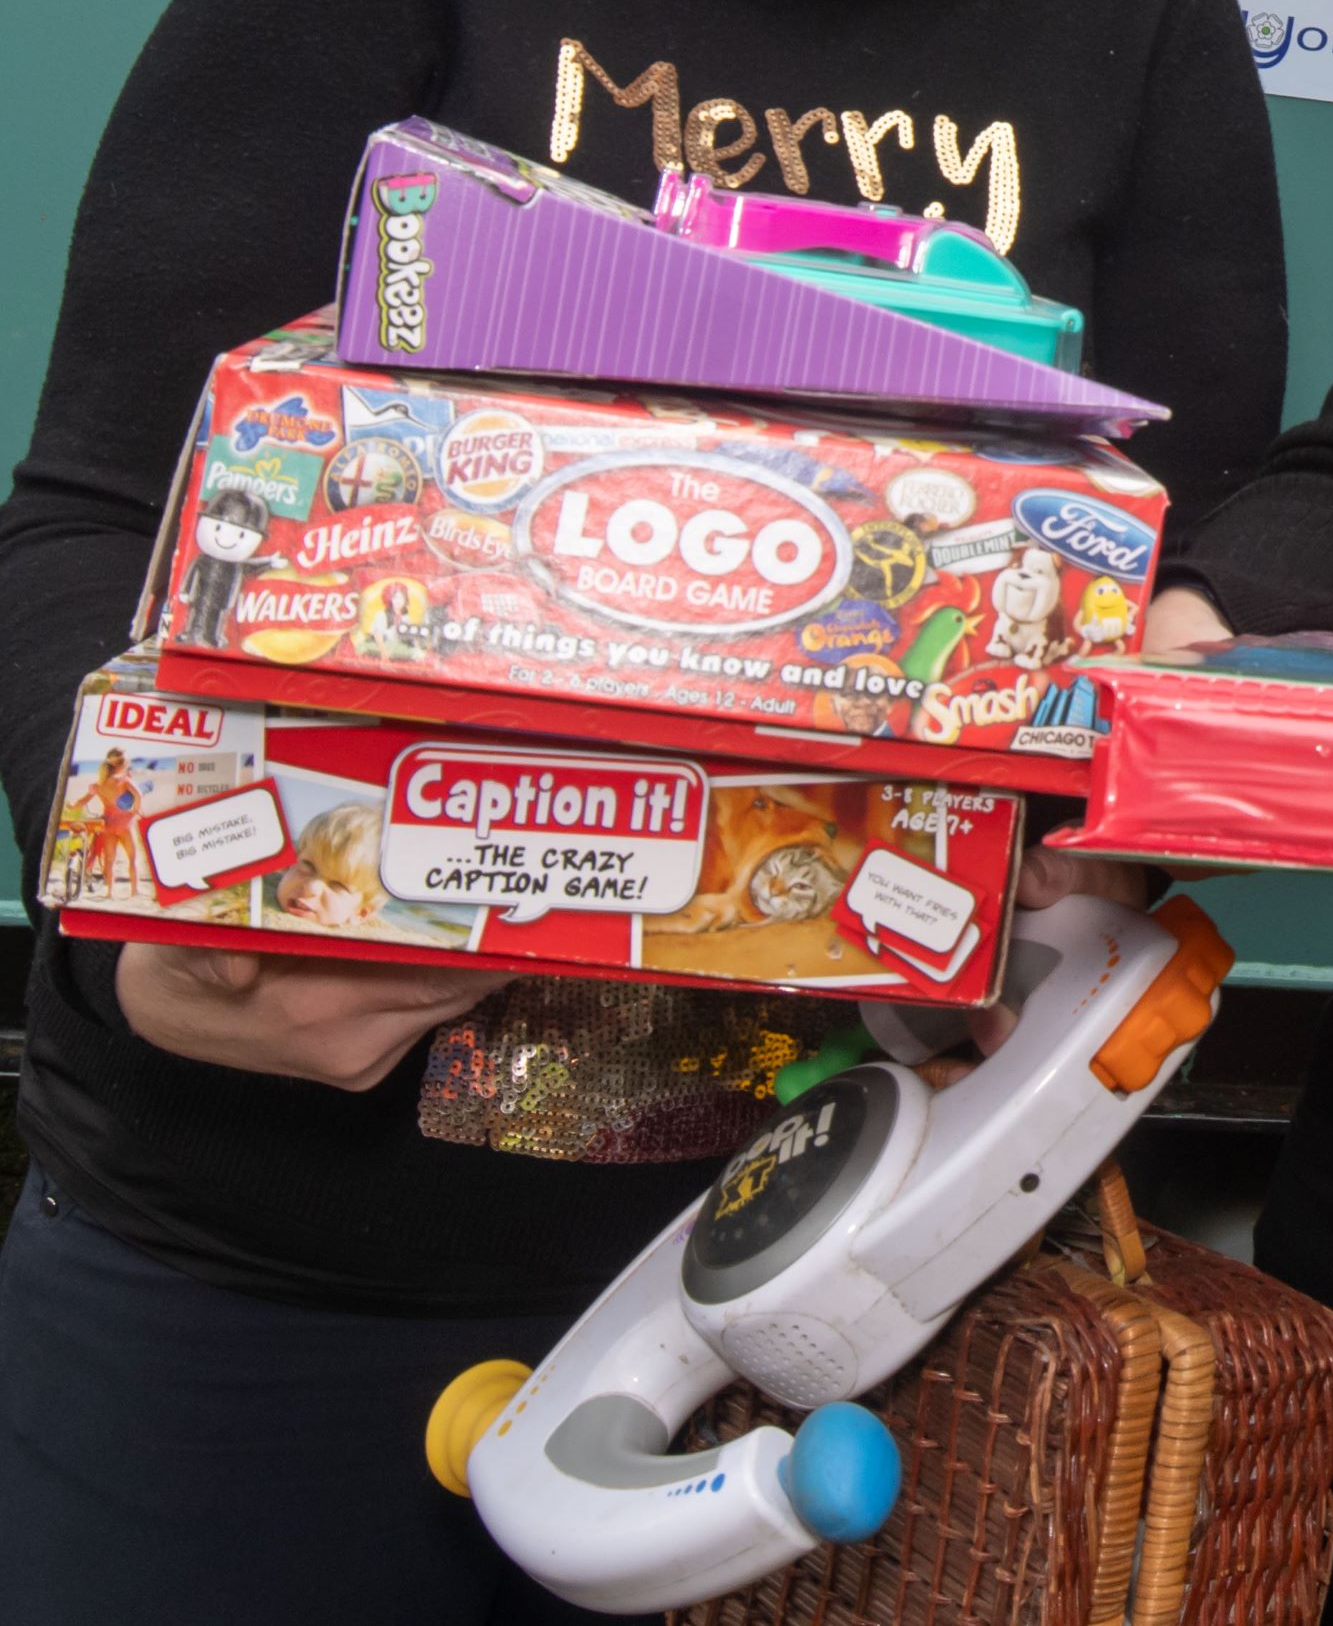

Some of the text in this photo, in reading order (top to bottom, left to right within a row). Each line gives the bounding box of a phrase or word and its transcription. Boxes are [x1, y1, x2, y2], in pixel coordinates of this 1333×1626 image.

[550, 36, 1022, 258] Merry
[374, 171, 437, 351] Bookeez
[447, 432, 533, 459] BURGER
[205, 460, 298, 505] Pampers
[446, 450, 534, 486] KING
[669, 472, 720, 502] The
[297, 515, 418, 567] Heinz
[553, 490, 823, 585] LOGO
[931, 531, 1016, 567] DOUBLEMINT
[1041, 502, 1148, 572] Ford
[236, 589, 359, 623] WALKERS
[577, 565, 774, 614] BOARD GAME
[443, 617, 924, 699] of things you know and love
[801, 623, 895, 655] Orange
[105, 700, 215, 740] IDEAL
[920, 673, 1039, 745] Smash
[1018, 731, 1084, 746] CHICAGO
[406, 763, 689, 839] Caption it!
[881, 784, 995, 813] 3-8 PLAYERS
[891, 808, 973, 836] AGE 7+
[541, 848, 634, 873] CRAZY
[426, 868, 648, 900] CAPTION GAME!
